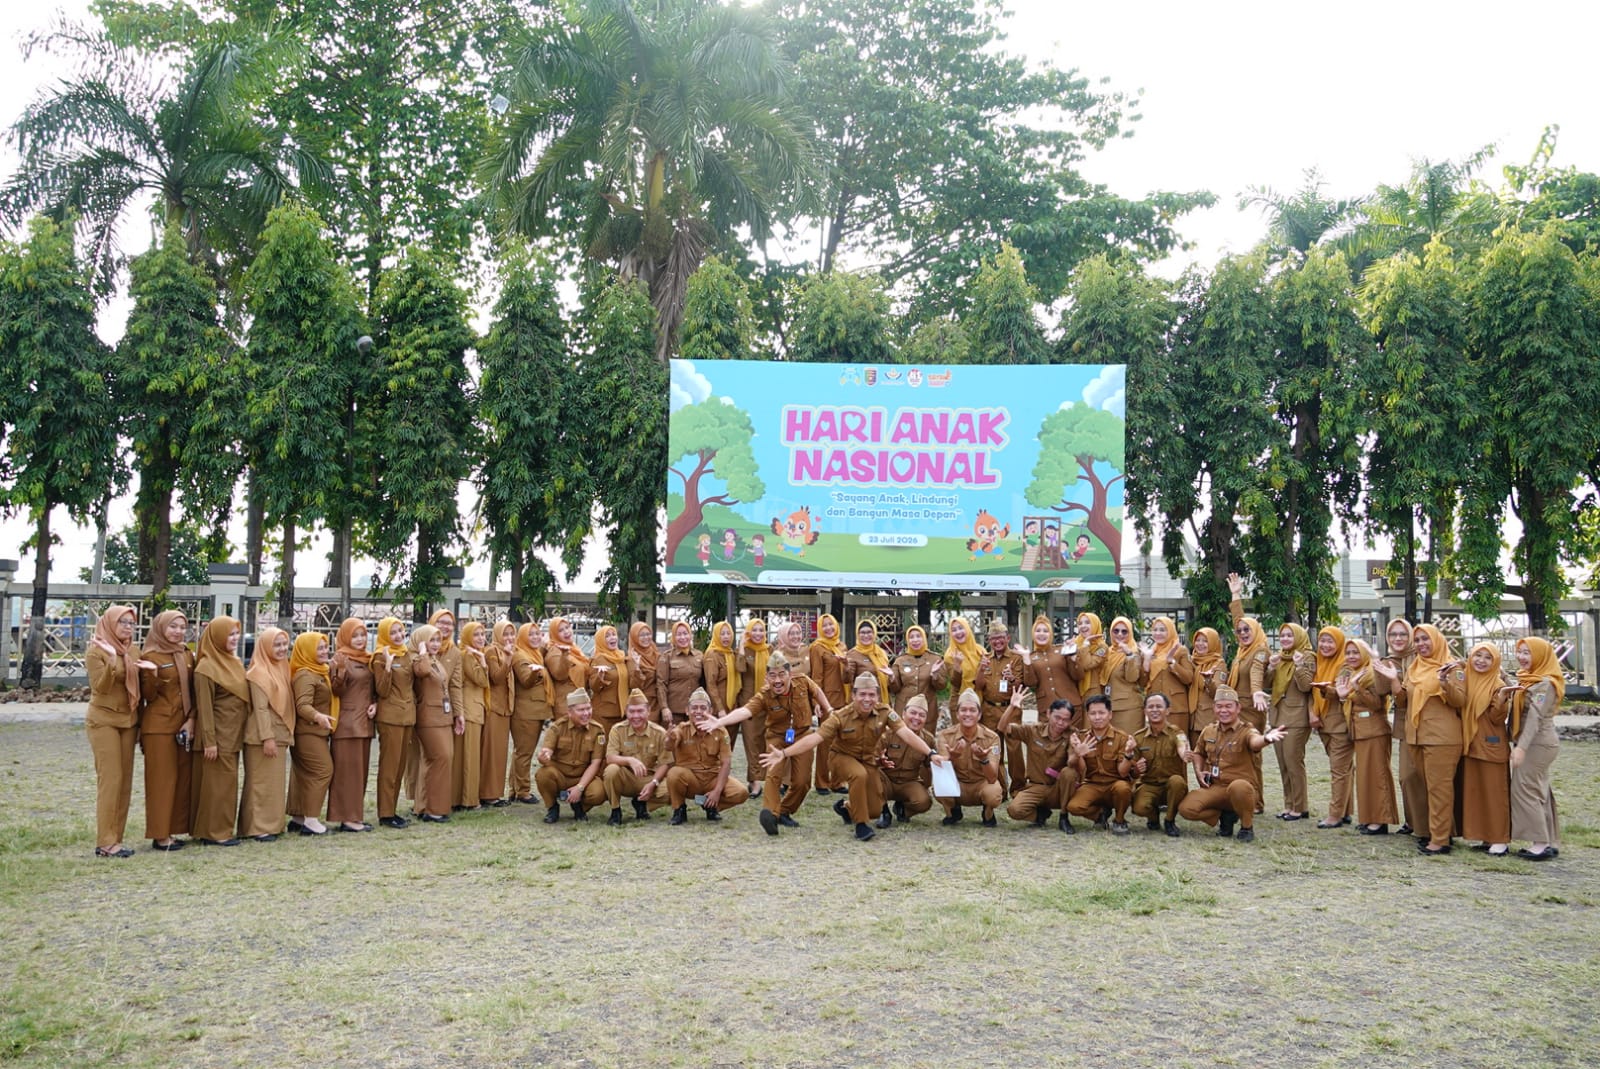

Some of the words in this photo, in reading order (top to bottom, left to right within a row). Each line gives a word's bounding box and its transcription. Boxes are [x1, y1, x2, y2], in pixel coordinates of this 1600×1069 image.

[784, 408, 883, 444] HARI
[889, 410, 1006, 448] ANAK
[792, 448, 998, 486] NASIONAL
[878, 493, 909, 504] Anak,
[911, 494, 958, 507] Lindungi
[826, 507, 846, 516] dan
[848, 507, 889, 520] Bangun
[891, 508, 921, 518] Masa
[868, 535, 879, 543] 23
[880, 536, 895, 544] Juli
[896, 536, 918, 544] 2026
